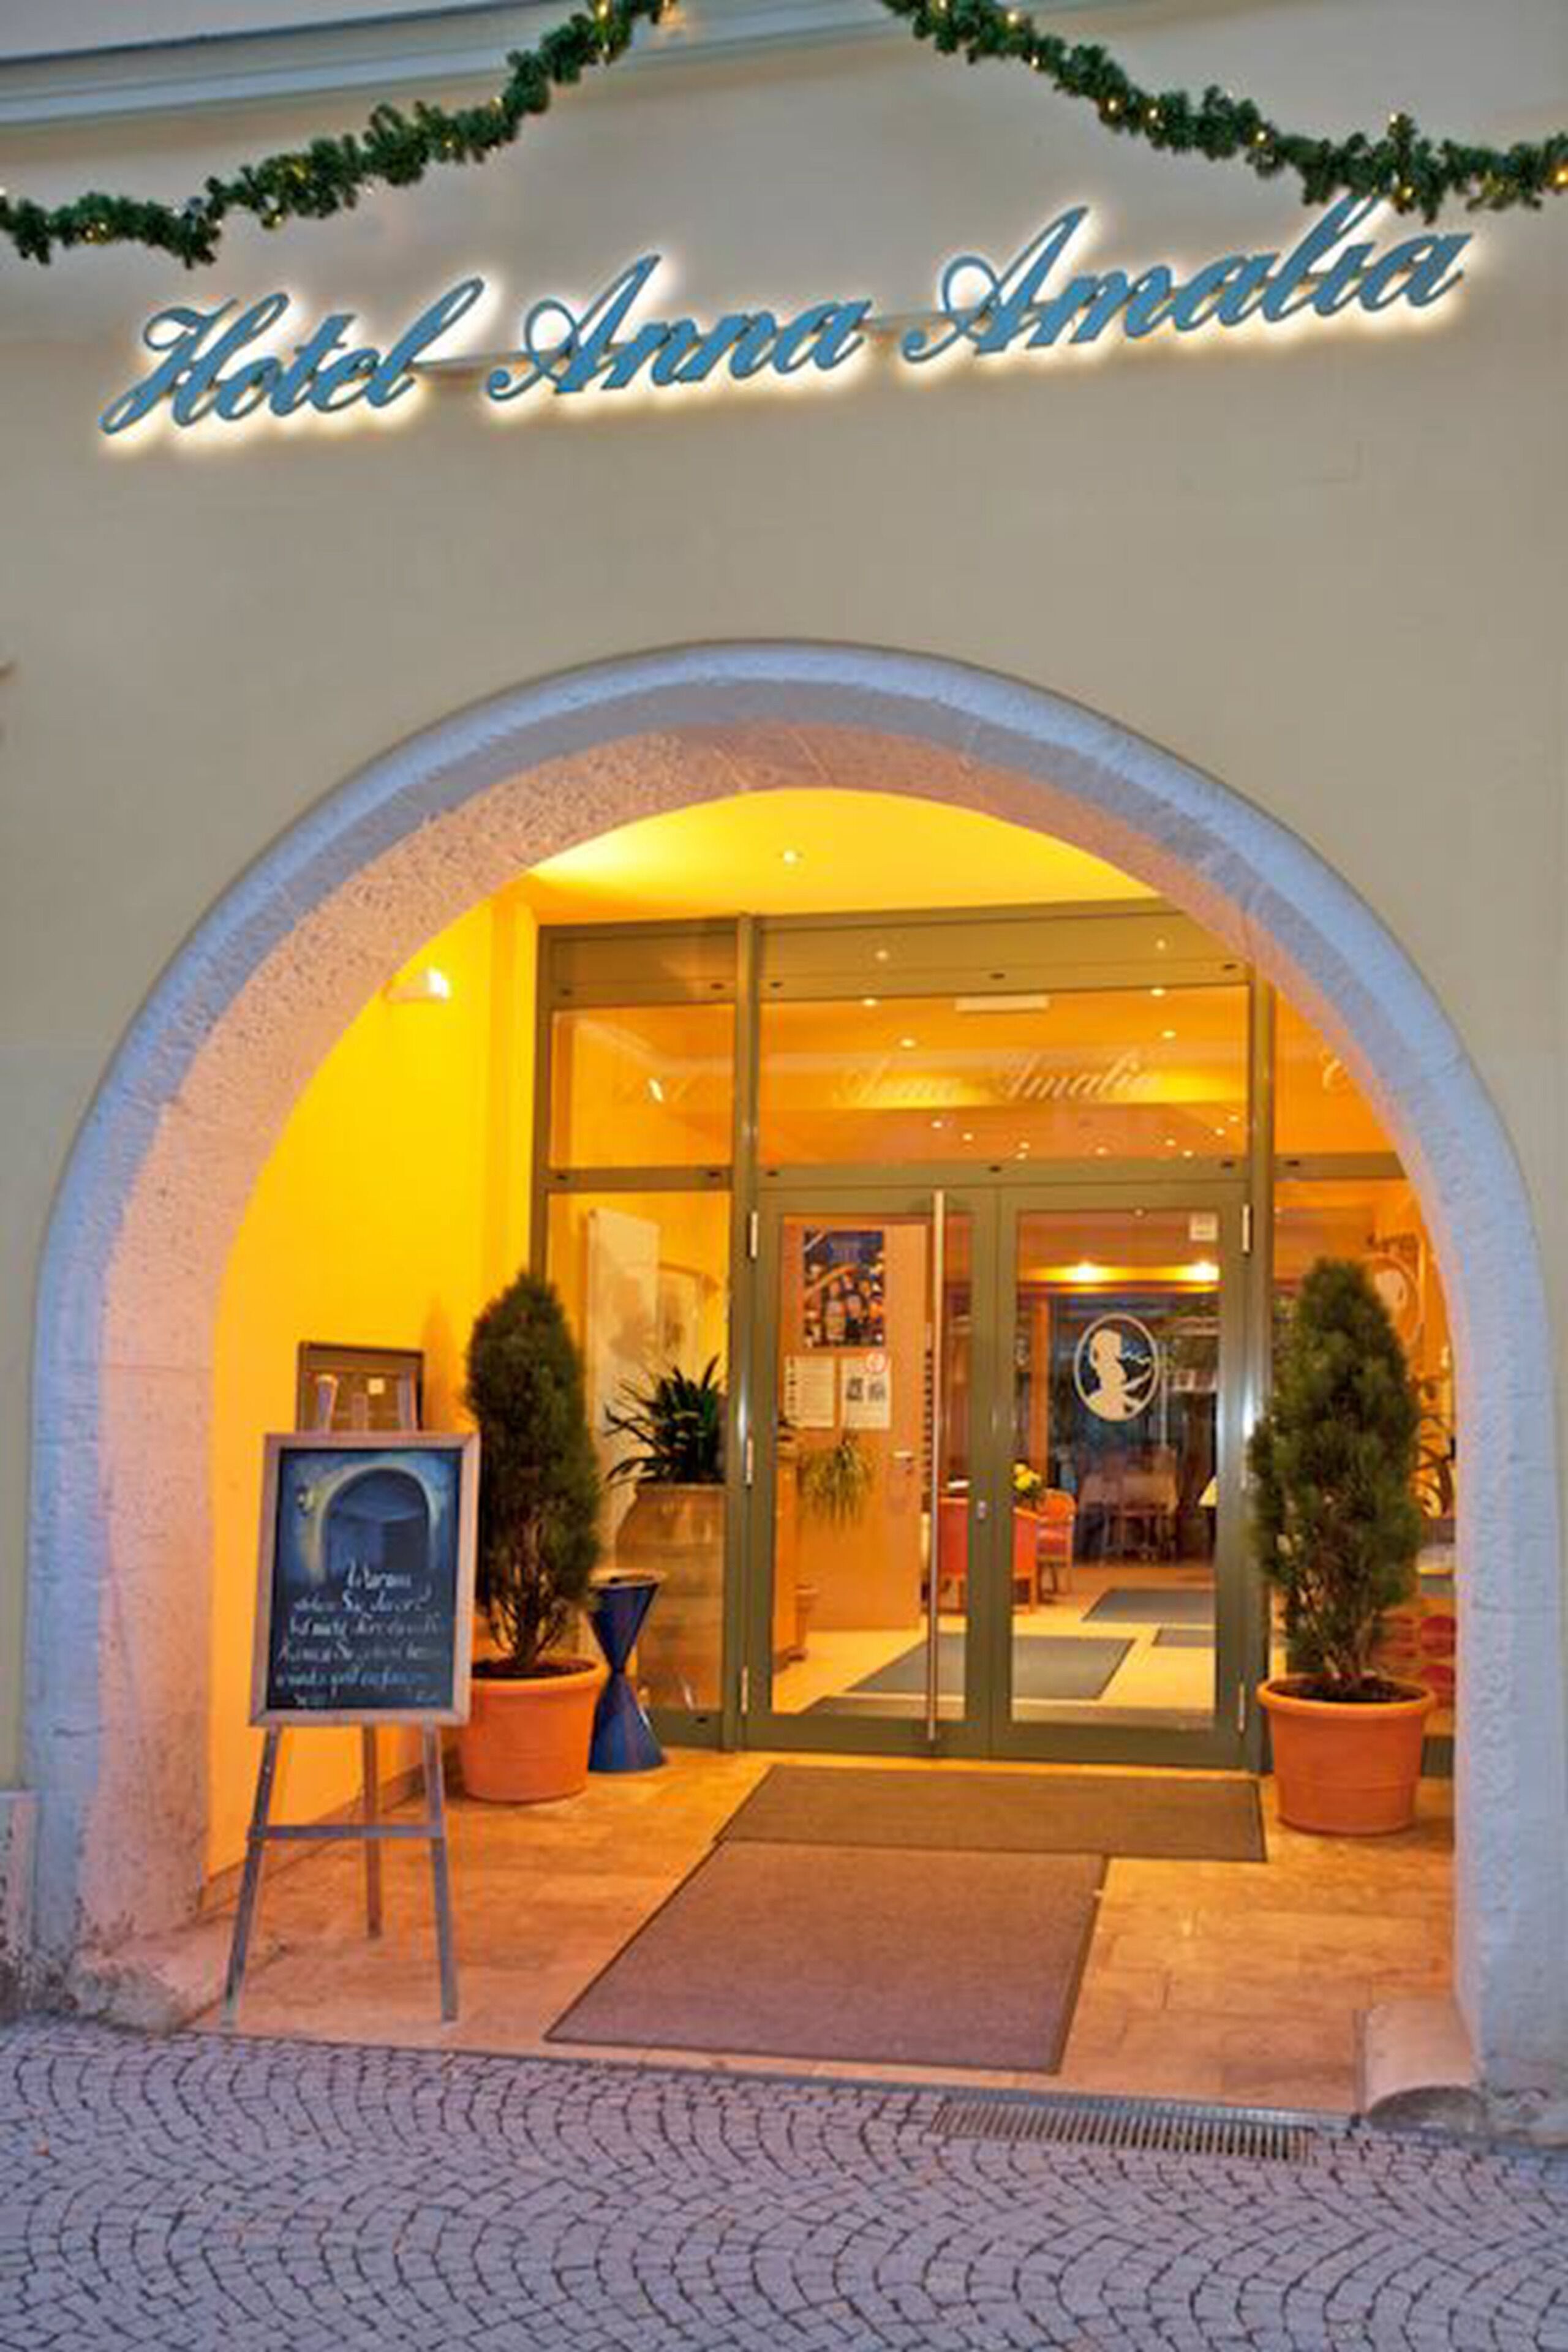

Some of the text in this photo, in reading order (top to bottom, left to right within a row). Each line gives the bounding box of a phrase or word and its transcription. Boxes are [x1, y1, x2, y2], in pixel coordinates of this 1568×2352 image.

[98, 195, 1474, 435] Hotel Anna Amalia
